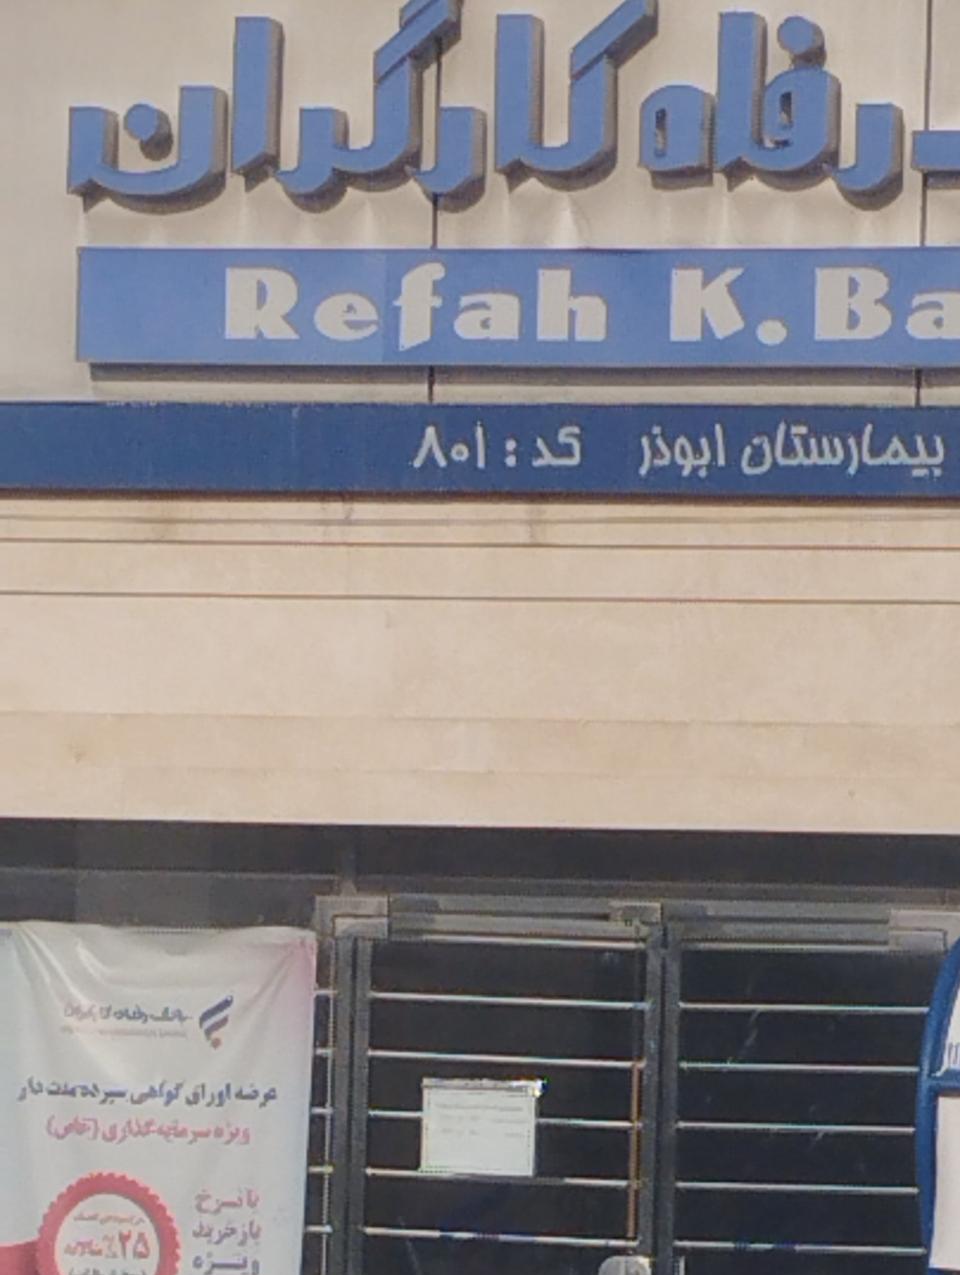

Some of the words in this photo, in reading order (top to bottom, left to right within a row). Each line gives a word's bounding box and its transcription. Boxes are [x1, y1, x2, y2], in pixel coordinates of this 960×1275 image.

[67, 0, 658, 195] کارگران
[640, 10, 902, 192] رفاه
[224, 262, 607, 350] Refah
[670, 266, 786, 346] K.
[638, 423, 726, 477] ابوذر
[740, 419, 944, 477] بیمارستان
[185, 1083, 231, 1108] اوراق
